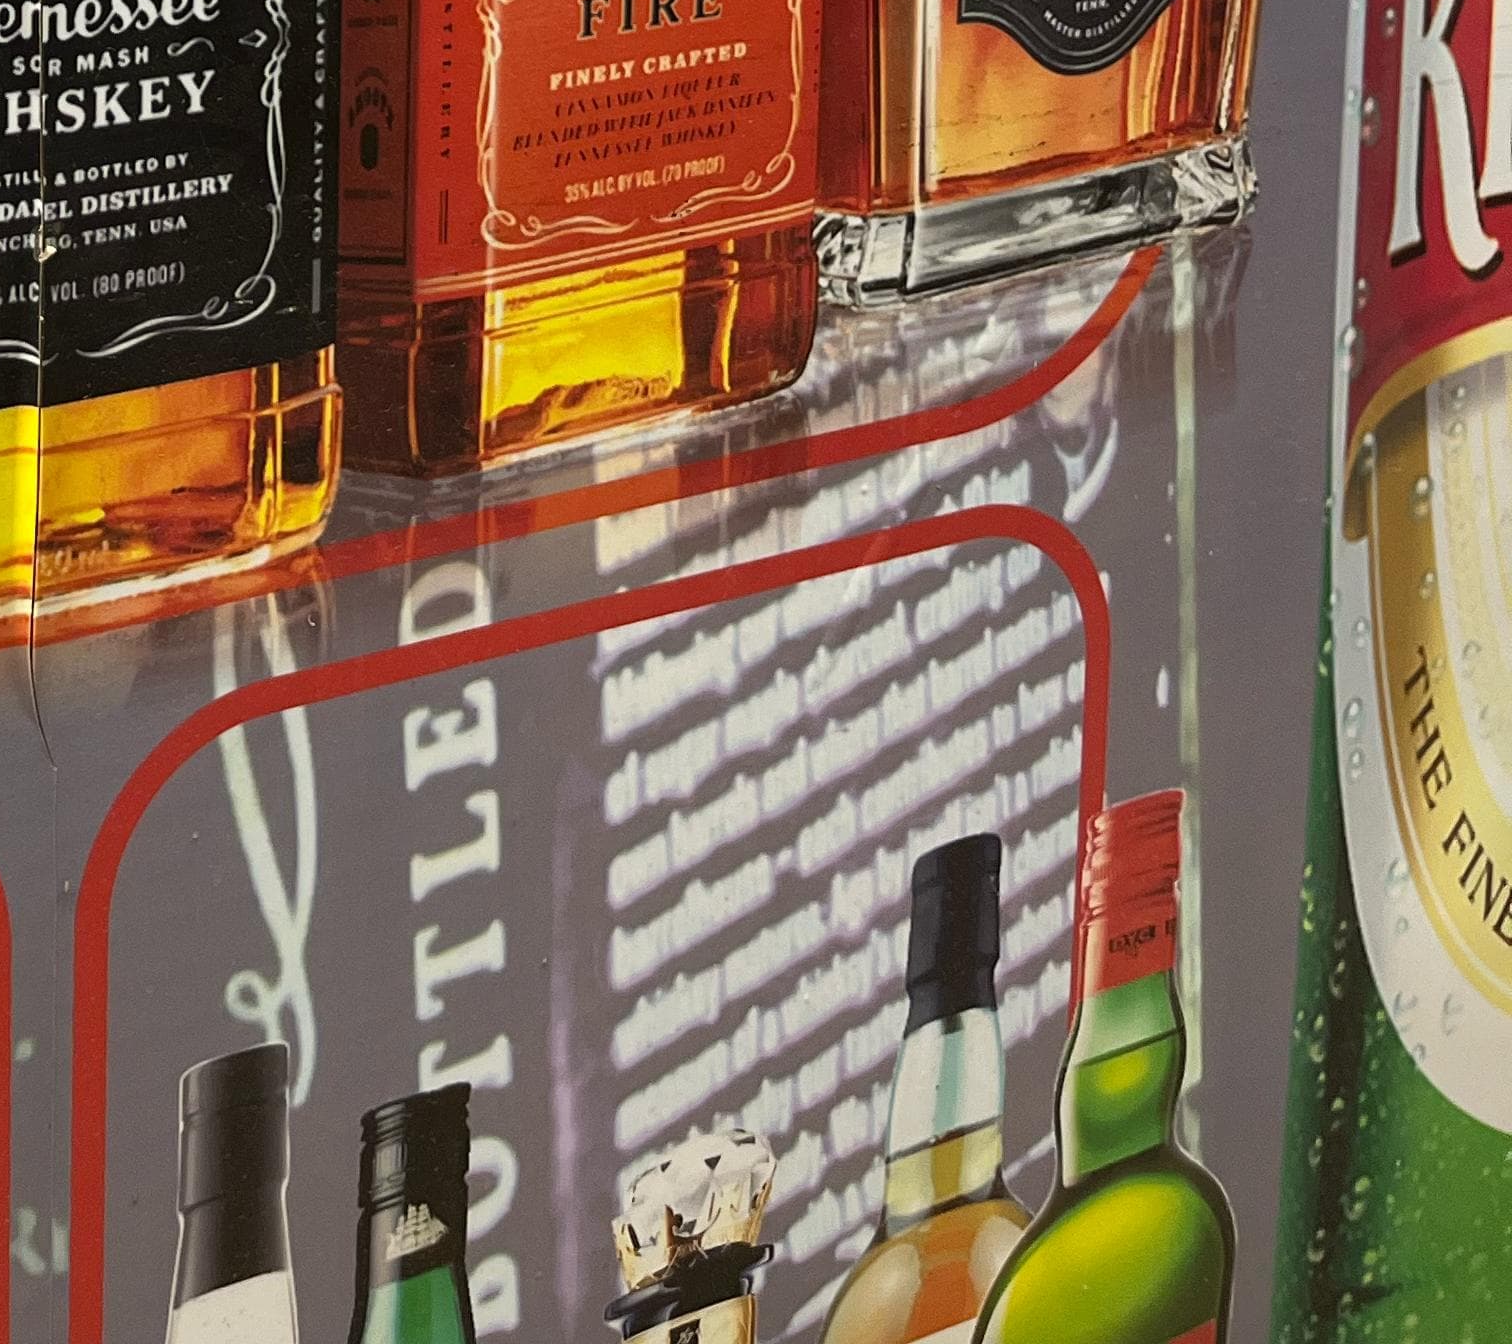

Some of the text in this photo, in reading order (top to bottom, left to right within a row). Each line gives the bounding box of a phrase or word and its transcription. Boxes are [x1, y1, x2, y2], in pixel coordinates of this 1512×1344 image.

[1043, 9, 1082, 39] MASTER
[76, 45, 150, 73] MASH
[549, 42, 748, 92] FINELY CRAFTED
[73, 156, 159, 184] BOTTLED
[165, 151, 189, 170] BY
[81, 173, 234, 216] DISTILLERY
[149, 214, 188, 235] USA
[125, 260, 187, 291] PROOF)
[1403, 643, 1453, 811] THE
